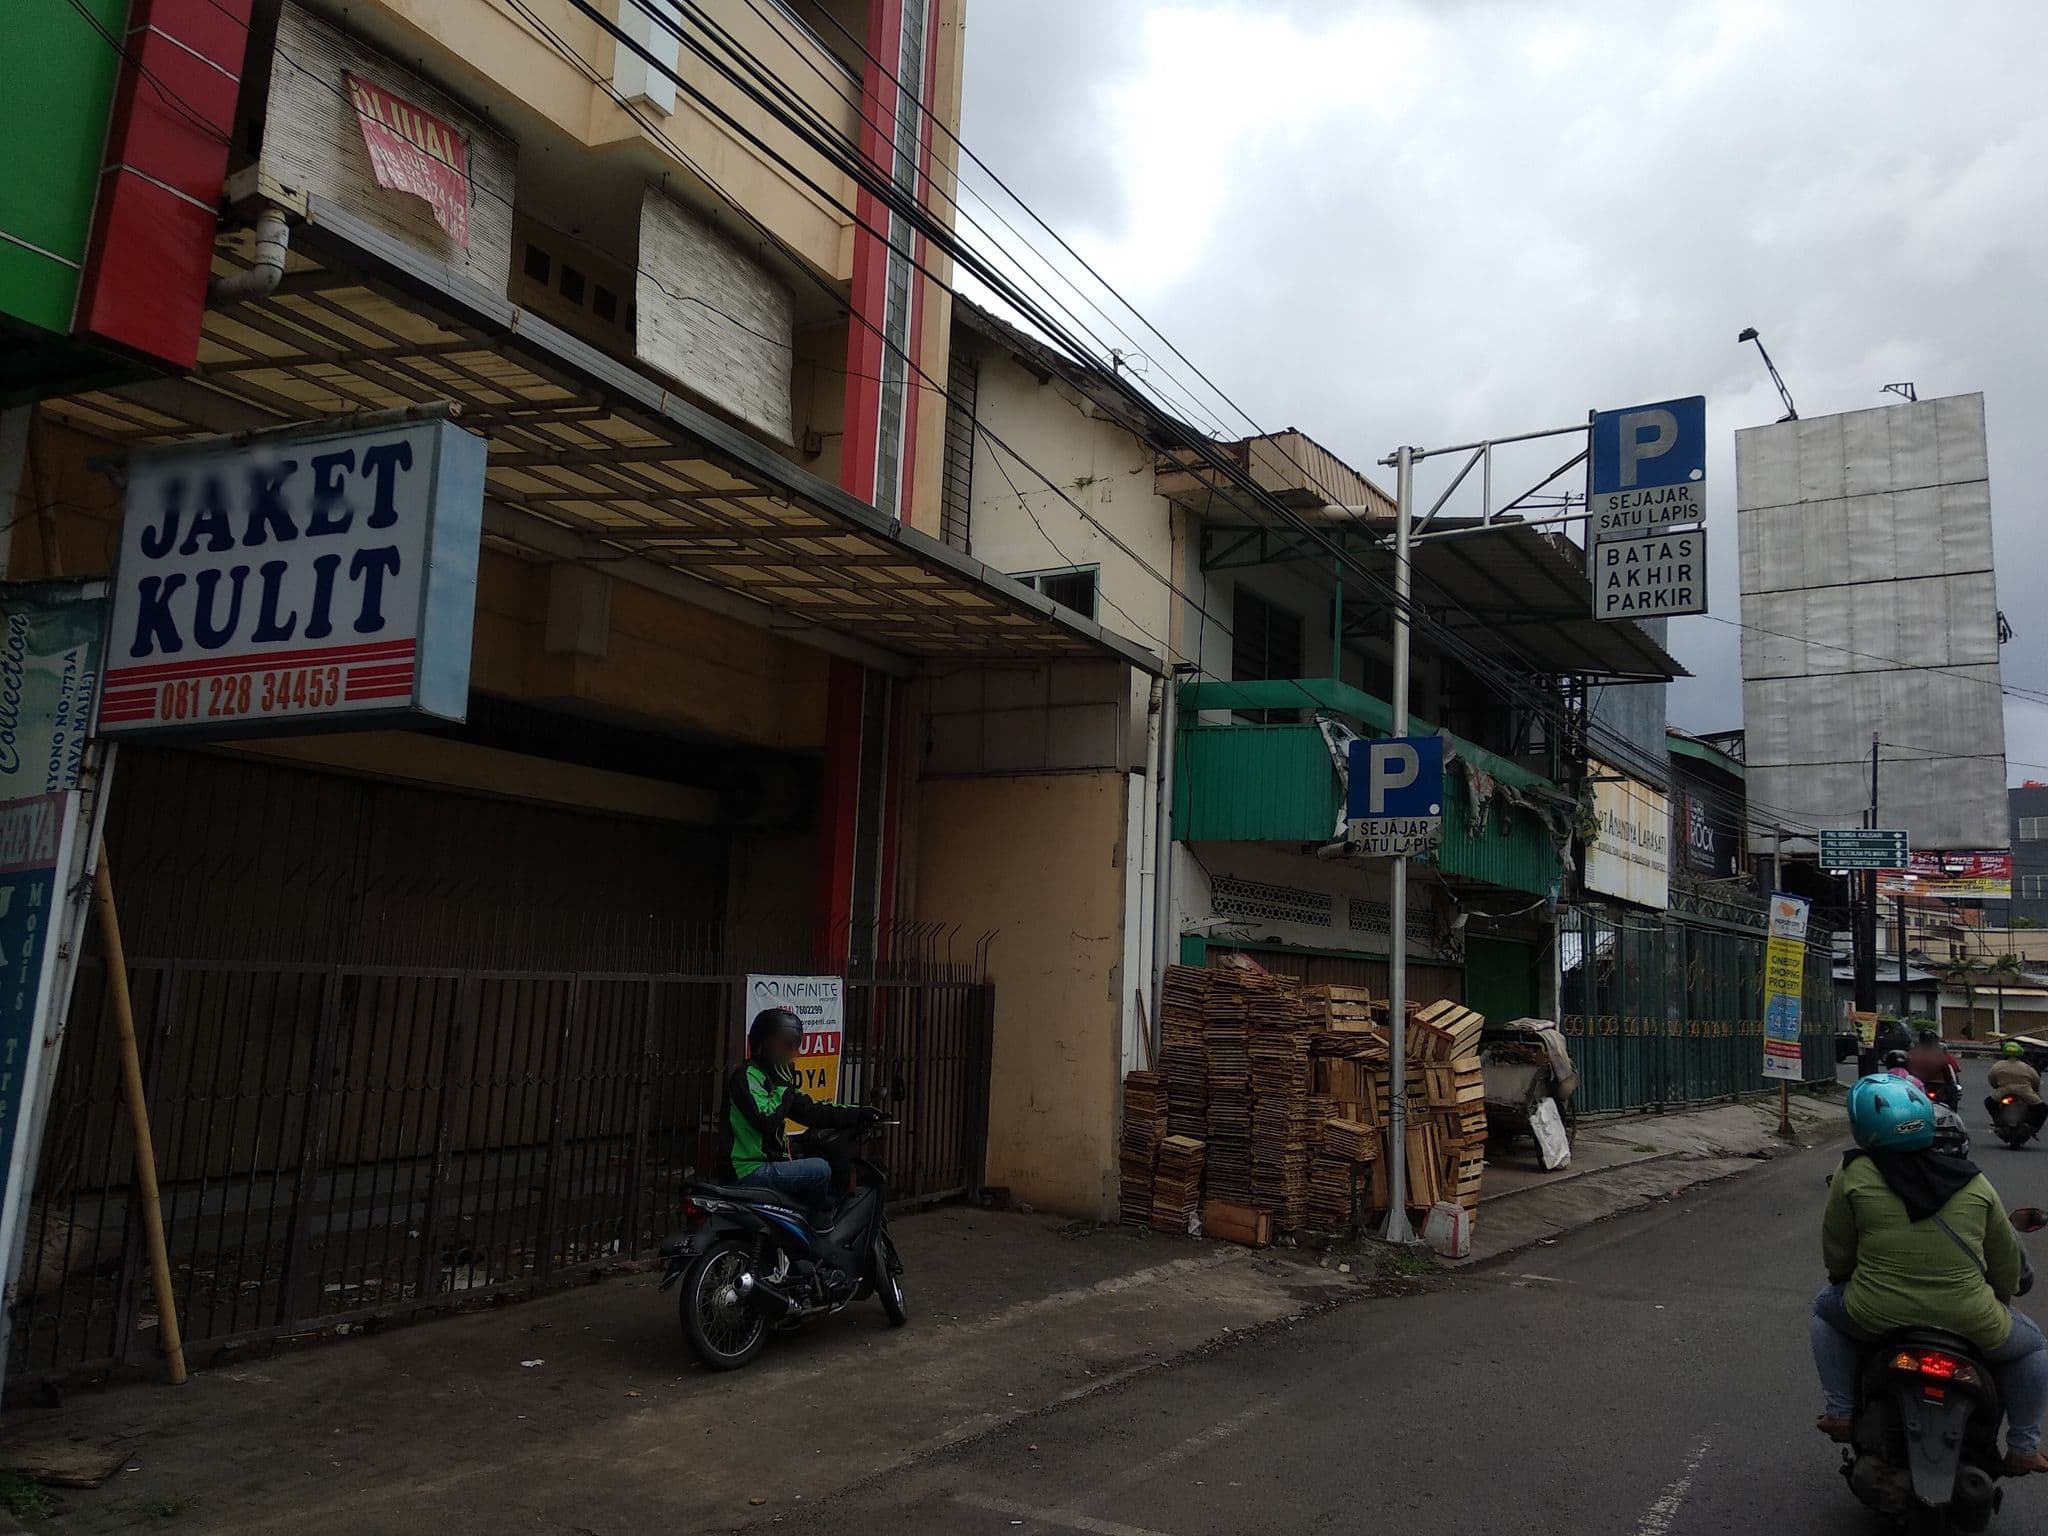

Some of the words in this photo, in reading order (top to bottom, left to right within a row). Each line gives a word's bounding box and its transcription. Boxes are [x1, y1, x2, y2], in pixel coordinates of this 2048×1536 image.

[1619, 409, 1678, 487] P
[141, 440, 412, 559] JAKET
[1610, 487, 1690, 510] SEJAJAR
[1600, 509, 1643, 529] SATU
[1649, 504, 1698, 523] LAPIS
[1607, 539, 1692, 566] BATAS
[1607, 564, 1692, 589] AKHIR
[130, 545, 401, 658] KULIT
[1606, 587, 1692, 612] PARKIR
[161, 679, 201, 720] 081
[208, 675, 252, 716] 228
[262, 666, 341, 712] 34453
[64, 739, 82, 786] JAVA
[1369, 743, 1420, 813] P
[1360, 821, 1428, 836] SEJAJAR
[1354, 839, 1388, 852] SATU
[783, 982, 838, 997] INFINITE
